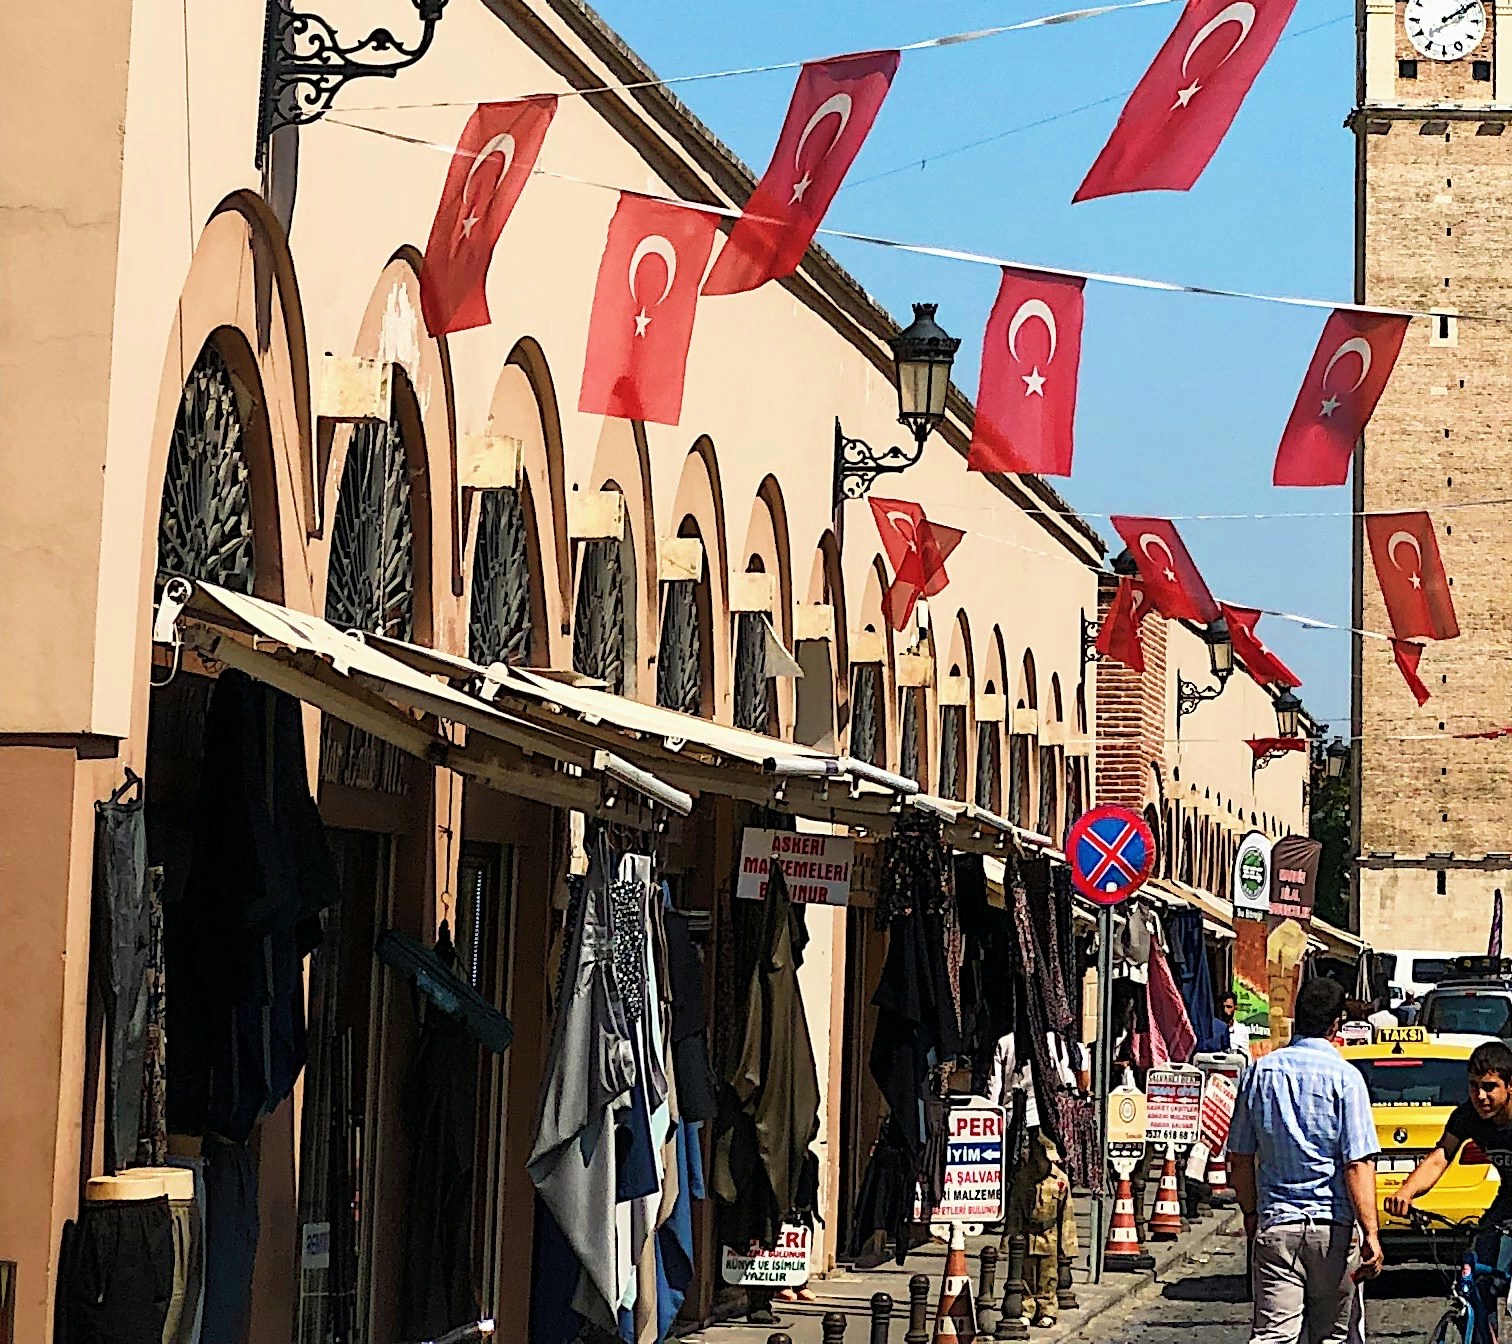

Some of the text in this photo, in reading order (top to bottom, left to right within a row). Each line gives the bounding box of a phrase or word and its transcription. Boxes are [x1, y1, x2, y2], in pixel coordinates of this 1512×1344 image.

[771, 835, 826, 857] ASKERİ
[743, 857, 849, 882] MAEMELERİ
[947, 1145, 981, 1162] İYİM
[744, 1272, 787, 1282] YAZILIR
